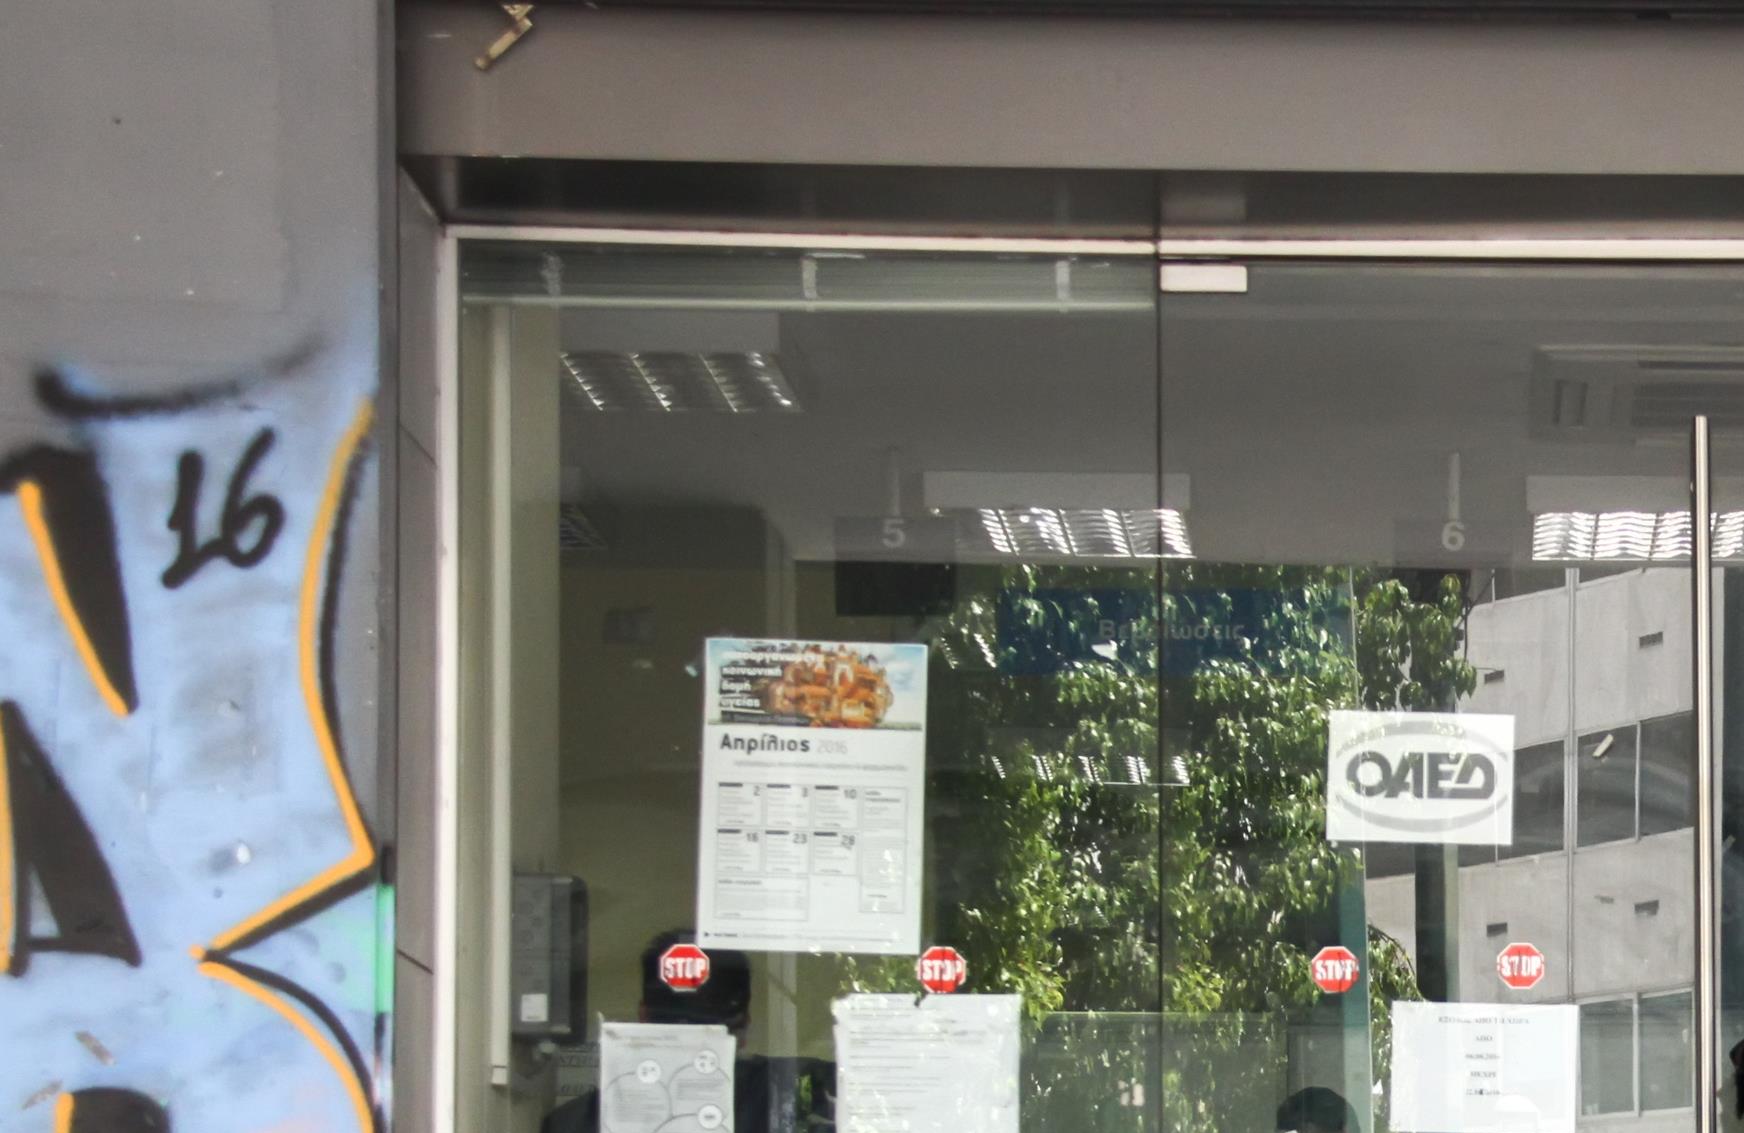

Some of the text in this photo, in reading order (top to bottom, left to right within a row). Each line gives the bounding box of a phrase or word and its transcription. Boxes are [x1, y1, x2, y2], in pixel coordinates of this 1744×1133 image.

[161, 427, 286, 590] 16
[882, 518, 905, 548] 5
[1441, 521, 1465, 551] 6
[720, 733, 810, 754] Απρίλιος
[1346, 750, 1497, 800] ΟΑΕΔ
[664, 957, 706, 979] STOP
[1500, 955, 1542, 977] STOP
